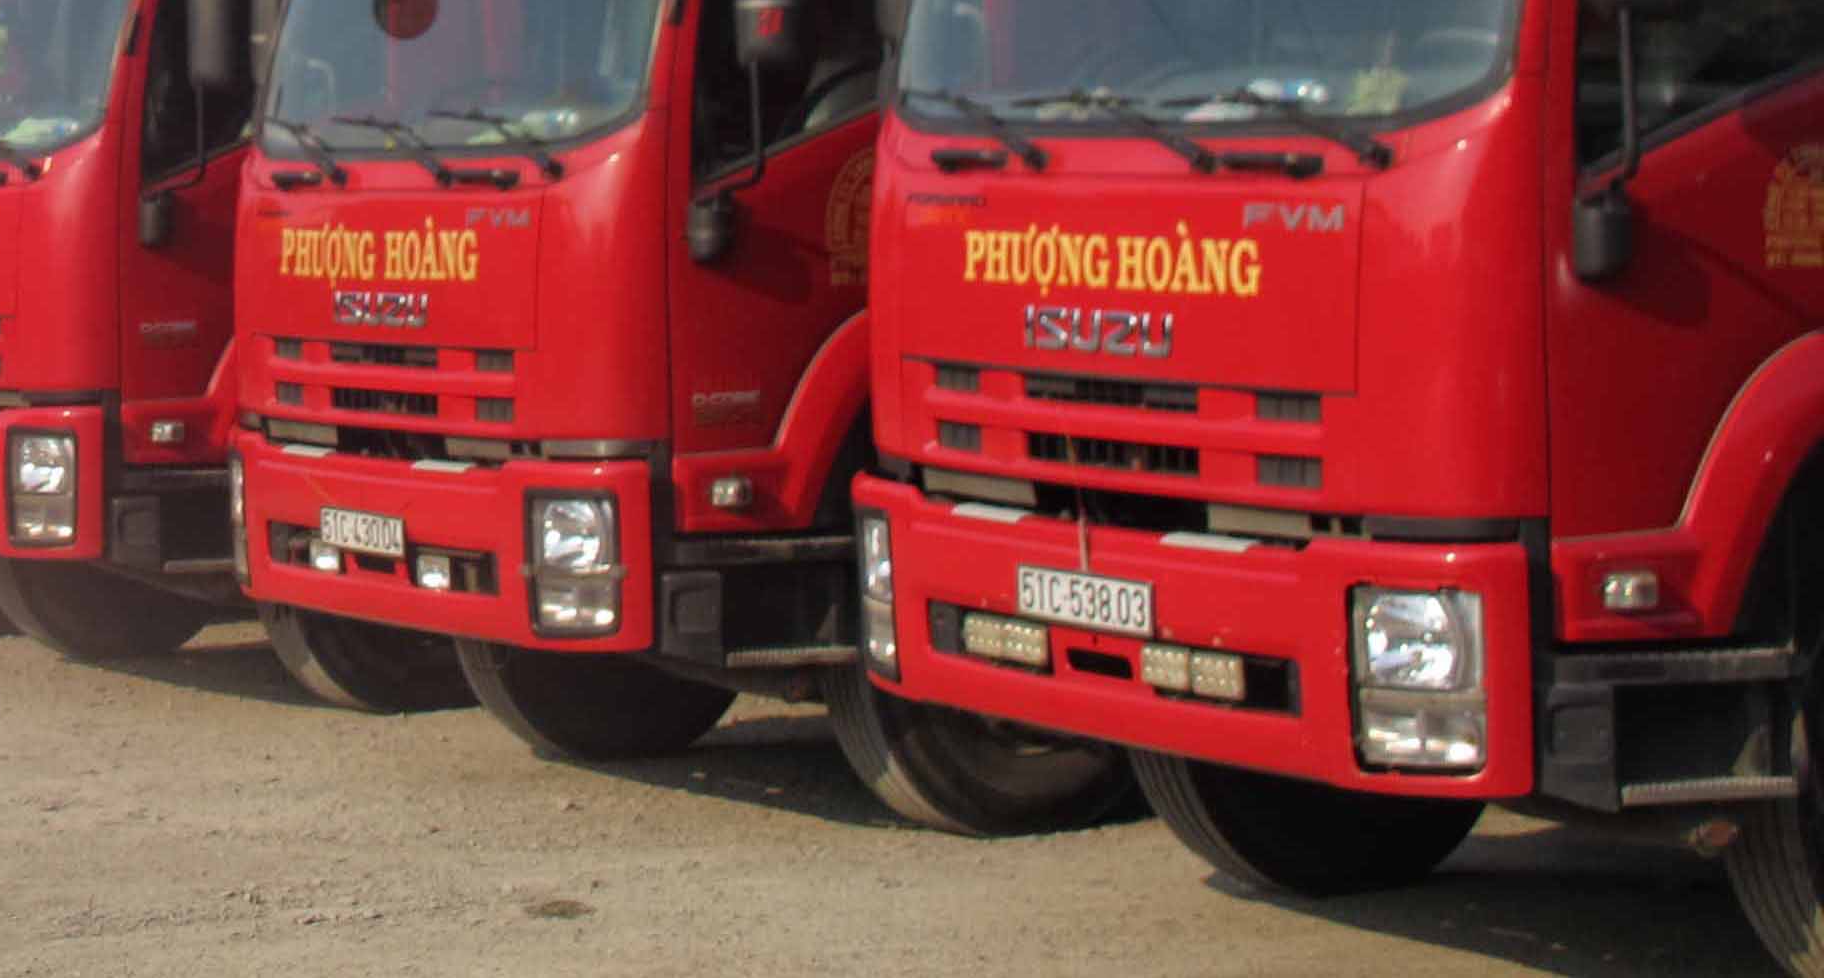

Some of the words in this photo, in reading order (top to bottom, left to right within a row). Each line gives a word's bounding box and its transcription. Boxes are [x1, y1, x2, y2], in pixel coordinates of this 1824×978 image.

[1242, 202, 1344, 231] FVM
[280, 223, 375, 288] PHƯỢNG
[383, 215, 479, 281] HOÀNG
[964, 224, 1109, 296] PHƯỢNG
[1116, 219, 1261, 296] HOÀNG
[333, 291, 428, 327] ISUZU
[1024, 304, 1174, 358] ISUZU
